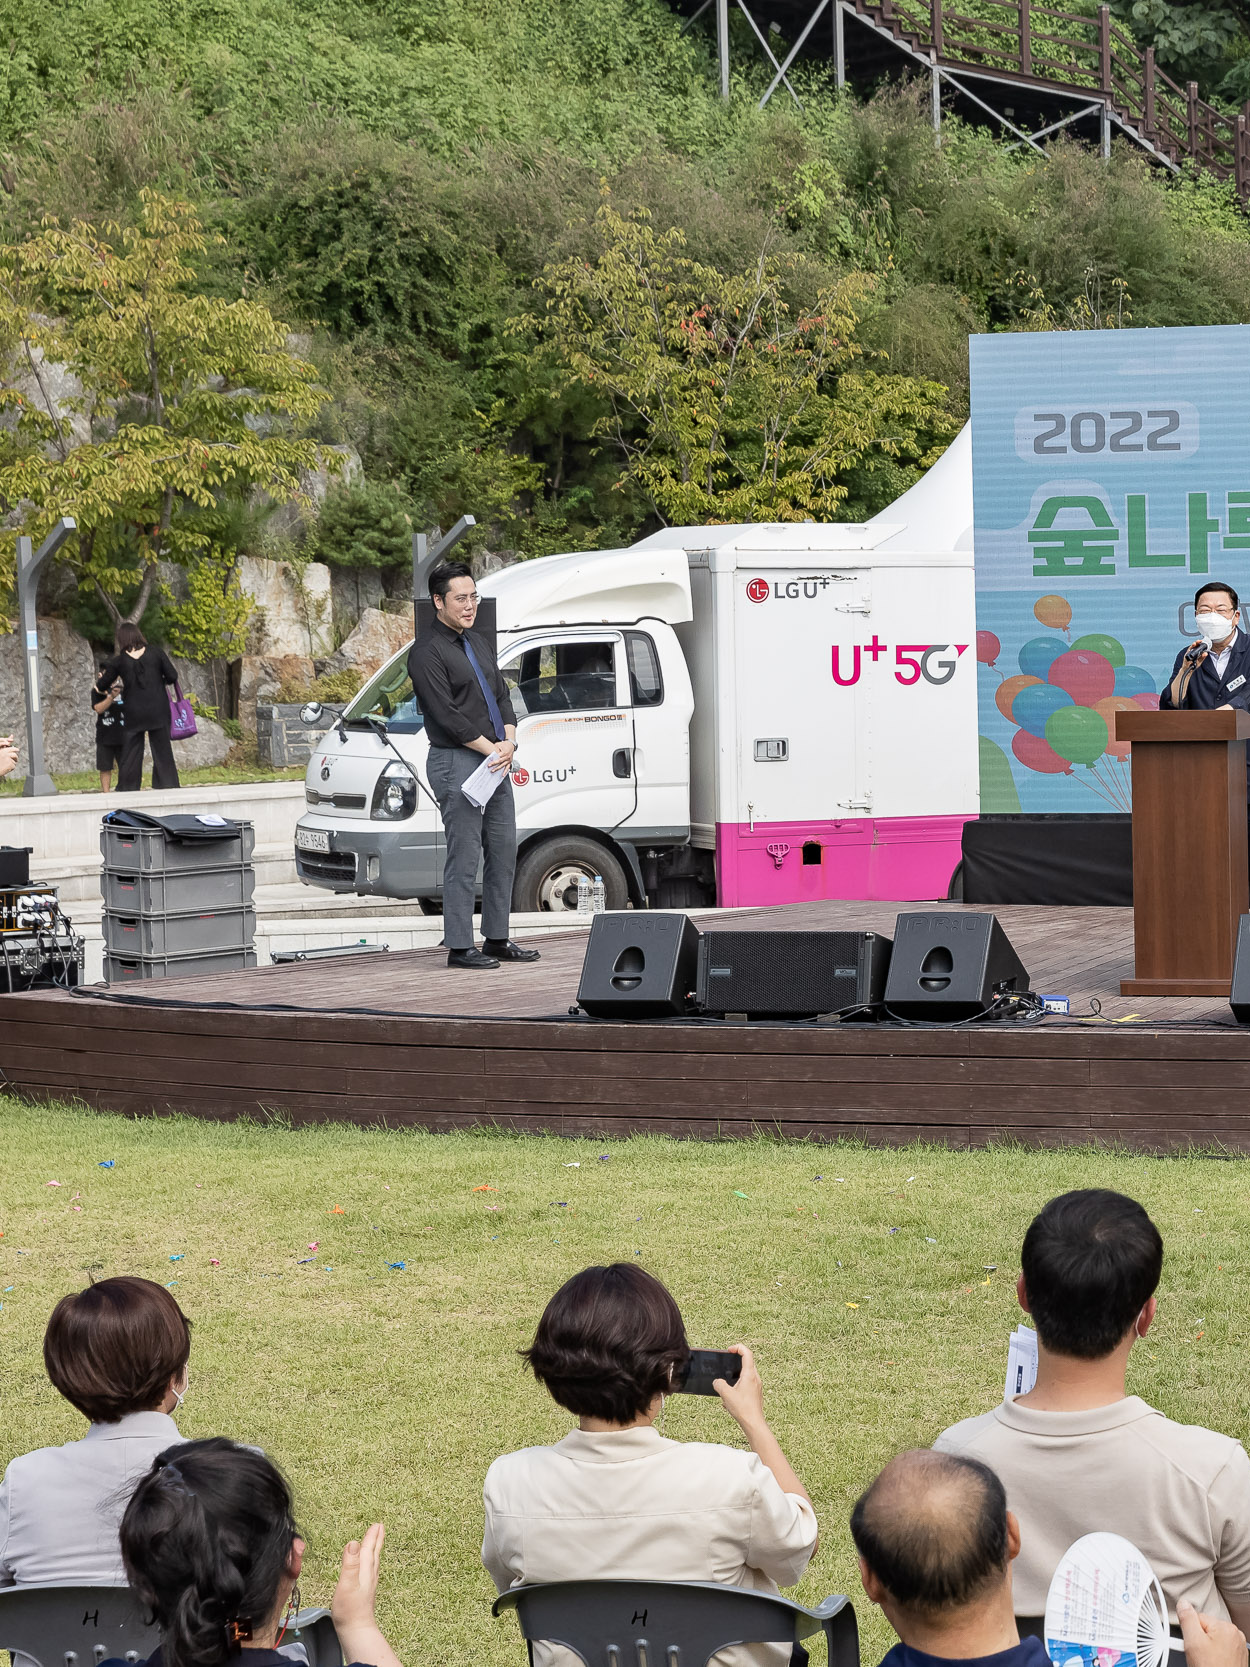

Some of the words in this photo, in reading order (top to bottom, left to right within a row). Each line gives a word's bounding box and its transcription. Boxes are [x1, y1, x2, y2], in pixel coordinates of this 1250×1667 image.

[1033, 410, 1182, 454] 2022
[831, 635, 888, 687] U+
[894, 644, 970, 686] 5G
